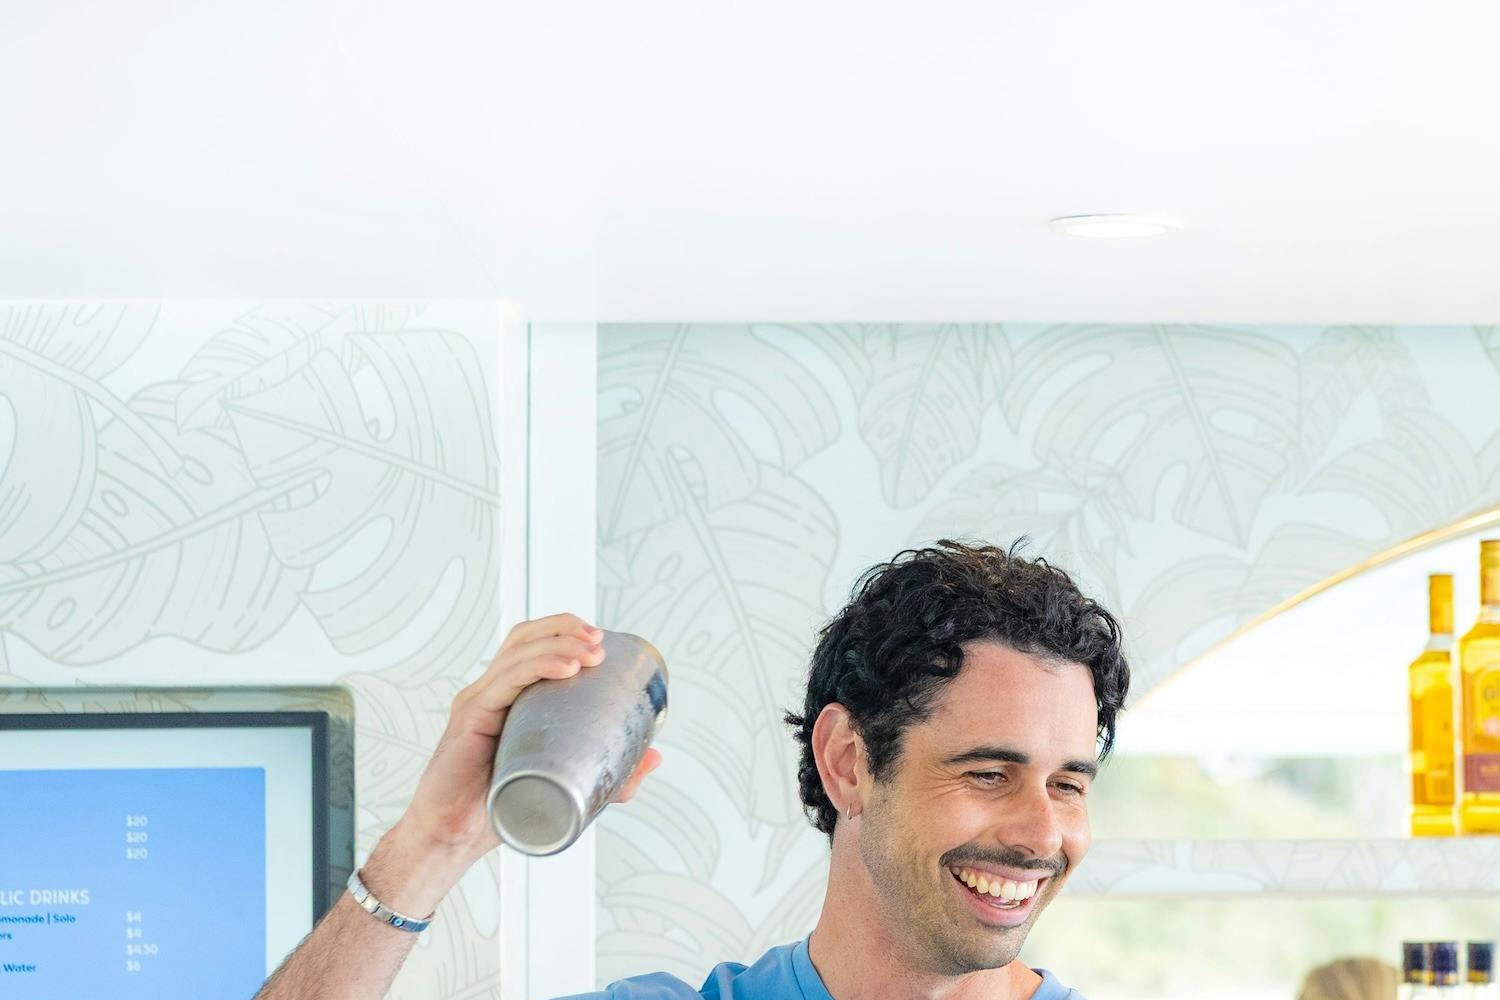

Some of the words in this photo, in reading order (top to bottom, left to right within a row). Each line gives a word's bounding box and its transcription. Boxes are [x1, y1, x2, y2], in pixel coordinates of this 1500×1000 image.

[29, 889, 90, 905] DRINKS
[0, 911, 45, 924] monade
[53, 912, 76, 924] Solo
[3, 963, 36, 974] Water
